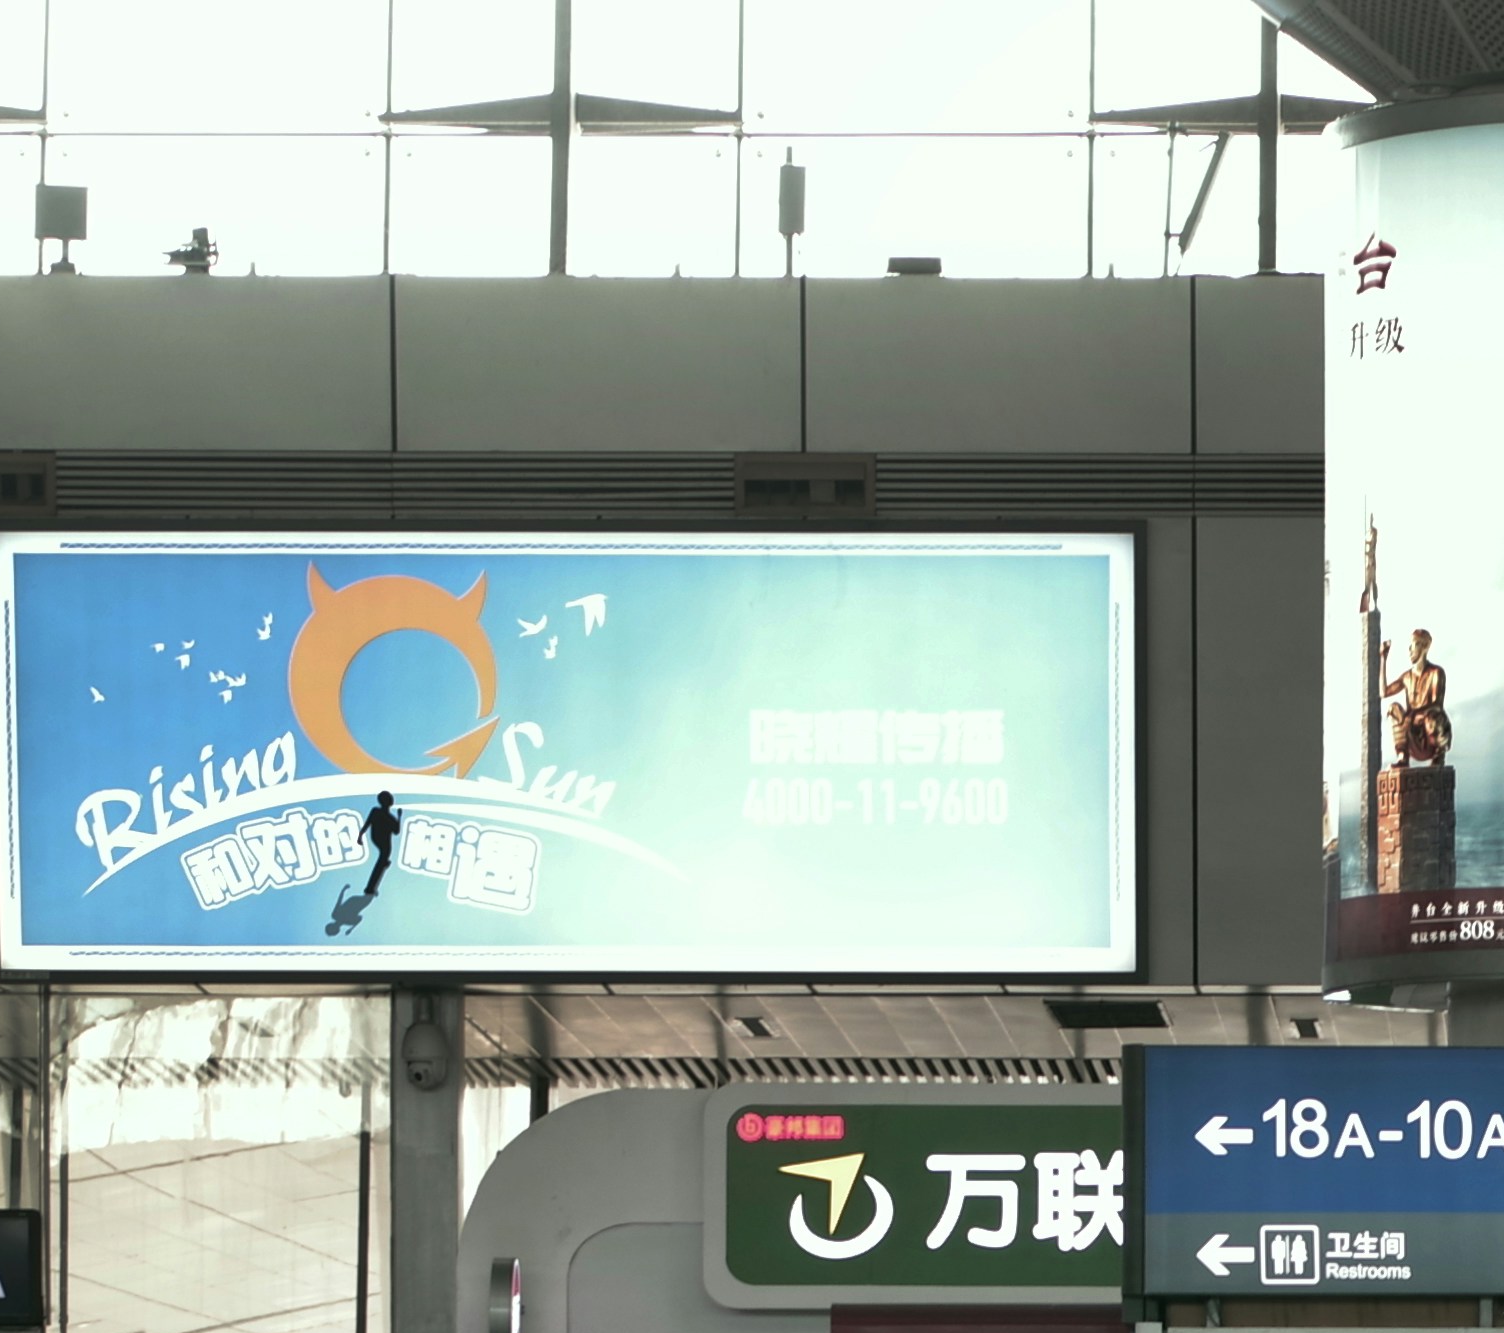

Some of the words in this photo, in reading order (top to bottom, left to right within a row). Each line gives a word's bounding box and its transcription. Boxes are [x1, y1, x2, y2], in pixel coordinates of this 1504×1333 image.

[1350, 317, 1405, 360] 升级
[74, 730, 299, 878] Rising
[486, 721, 618, 819] Sun
[925, 1148, 1123, 1252] 万联
[1325, 1231, 1406, 1262] 卫生间
[1325, 1262, 1412, 1281] Restrooms
